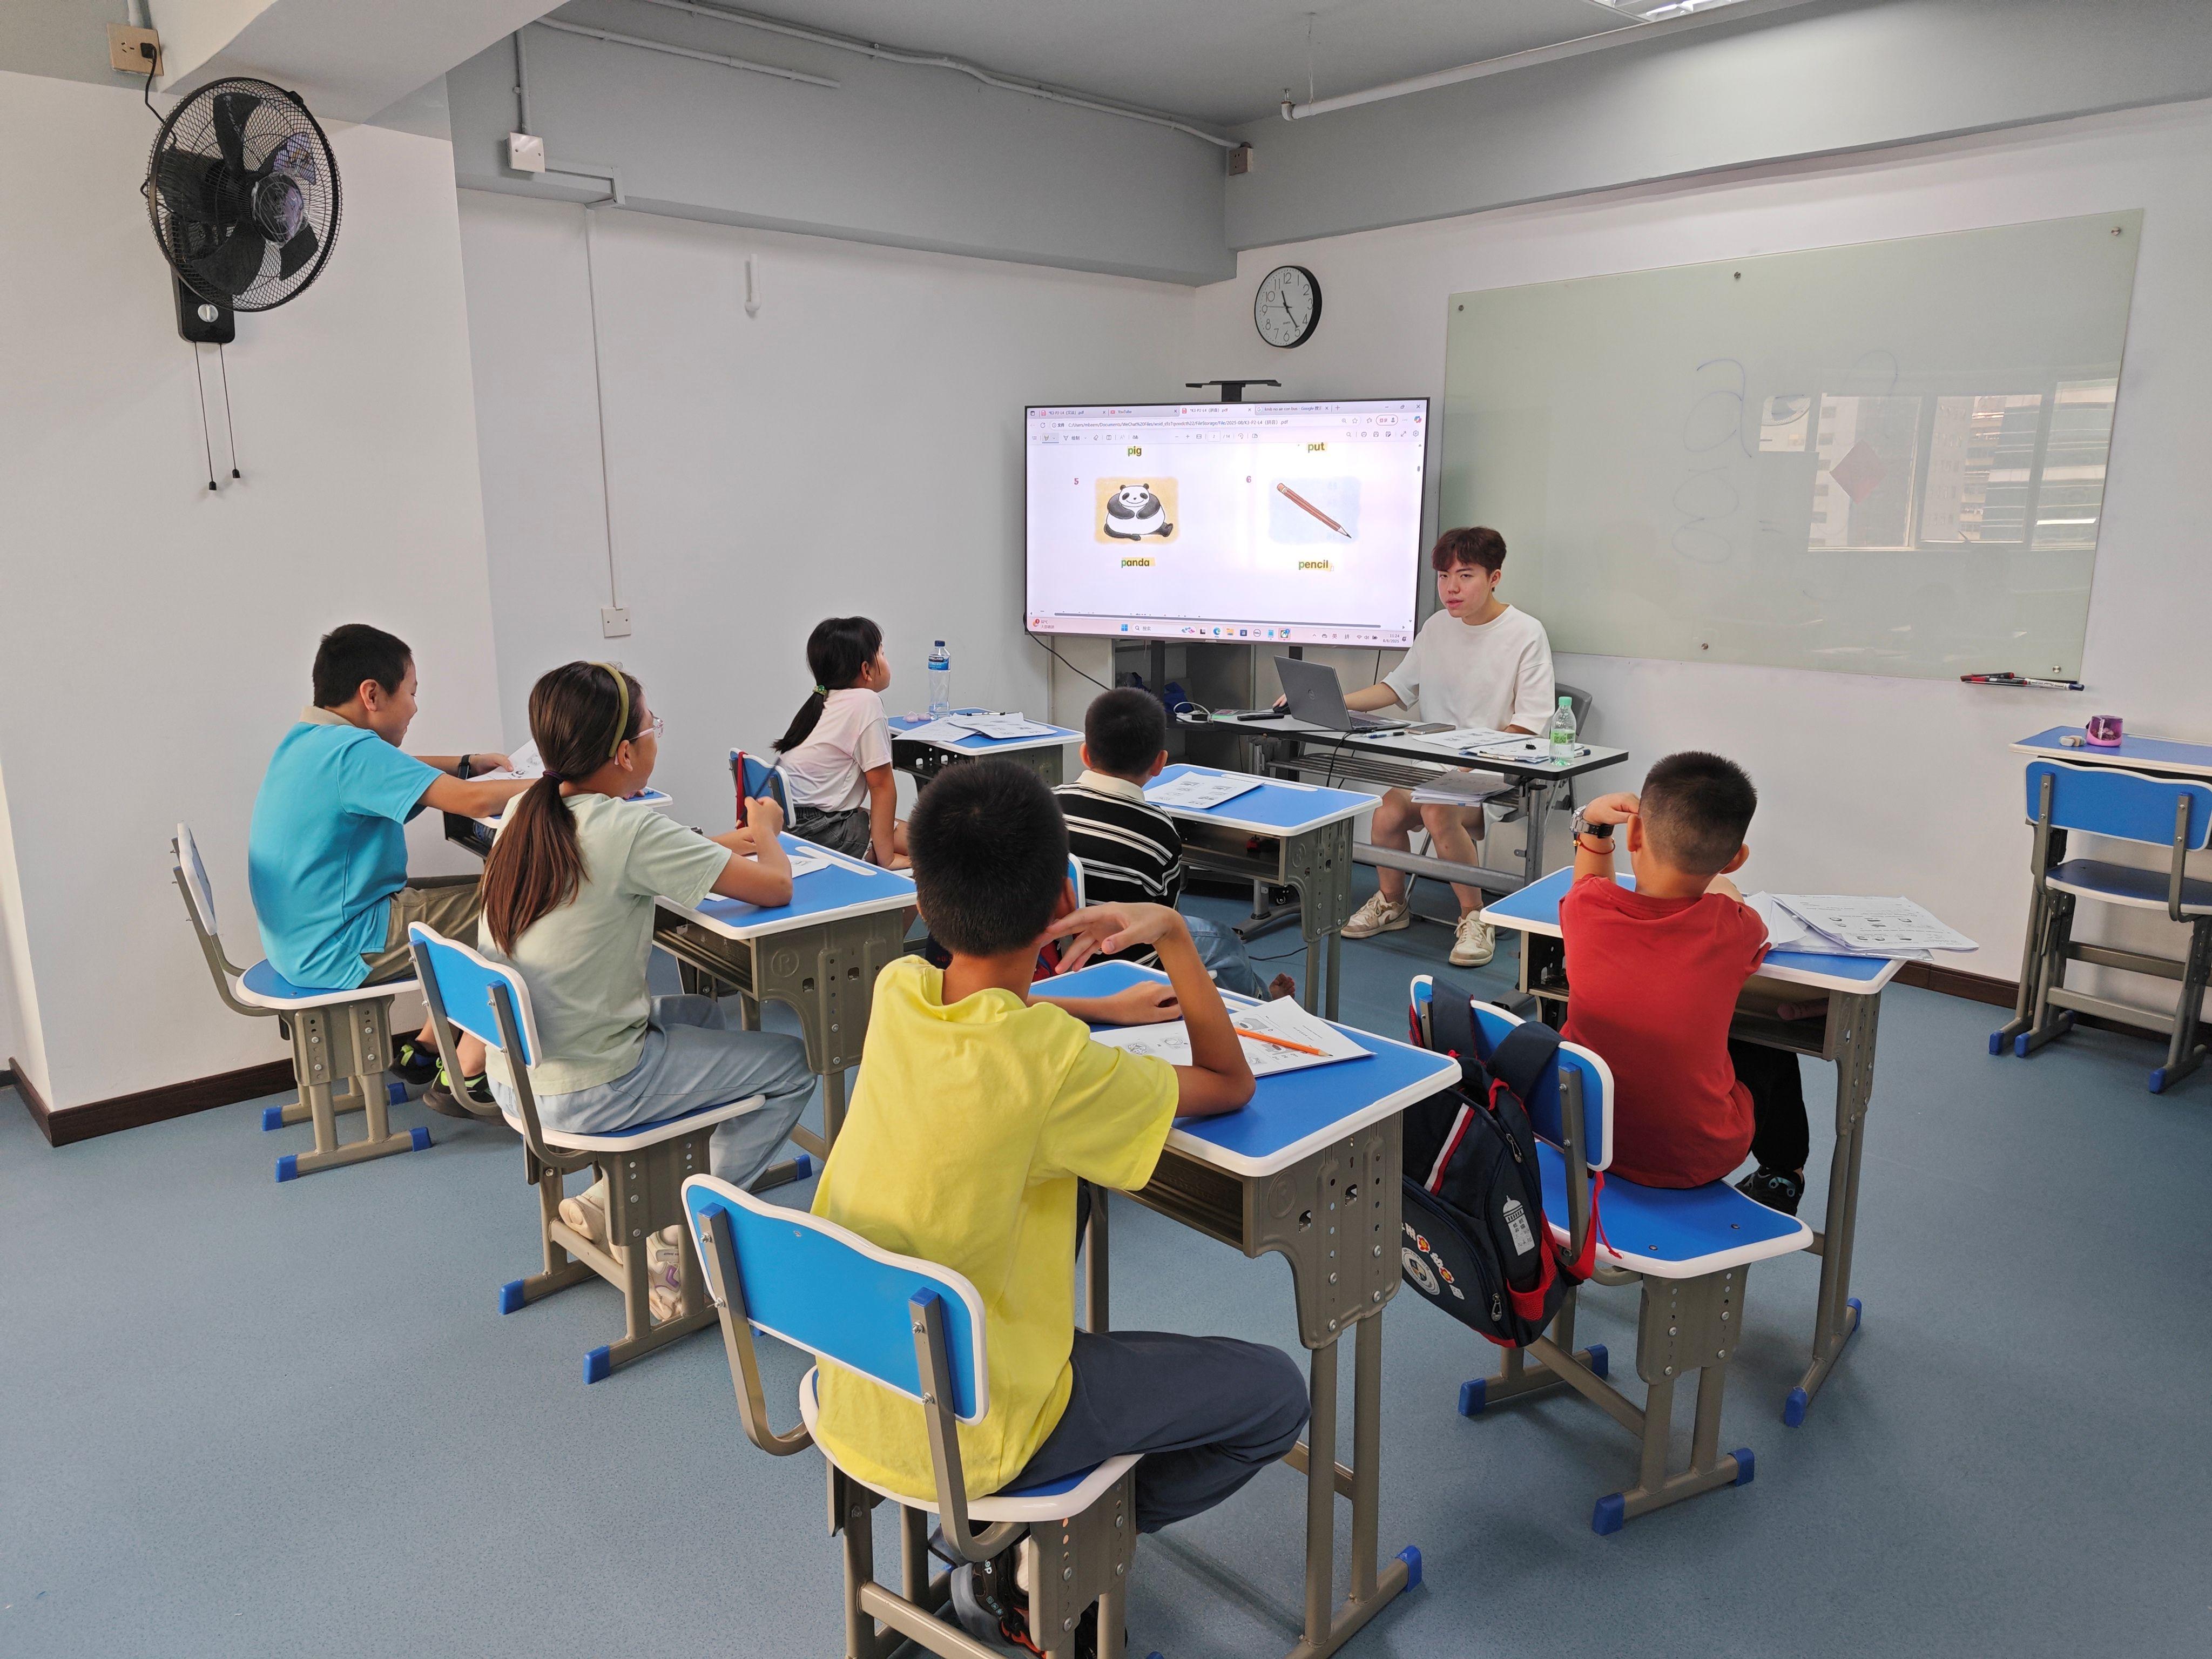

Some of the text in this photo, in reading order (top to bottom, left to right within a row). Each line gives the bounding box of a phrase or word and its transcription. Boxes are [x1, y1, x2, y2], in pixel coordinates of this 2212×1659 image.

[1283, 272, 1292, 284] 12
[1274, 278, 1280, 291] 11
[1303, 284, 1310, 295] 2
[1265, 291, 1275, 302] 10
[1307, 298, 1313, 310] 3
[1262, 305, 1268, 316] 9
[1265, 319, 1271, 330] 8
[1302, 313, 1308, 325] 4
[1273, 328, 1279, 340] 7
[1283, 330, 1290, 342] 6
[1294, 326, 1301, 337] 5
[1127, 446, 1142, 457] pig
[1307, 442, 1325, 453] put
[1121, 557, 1150, 568] panda
[1298, 559, 1329, 570] pencil
